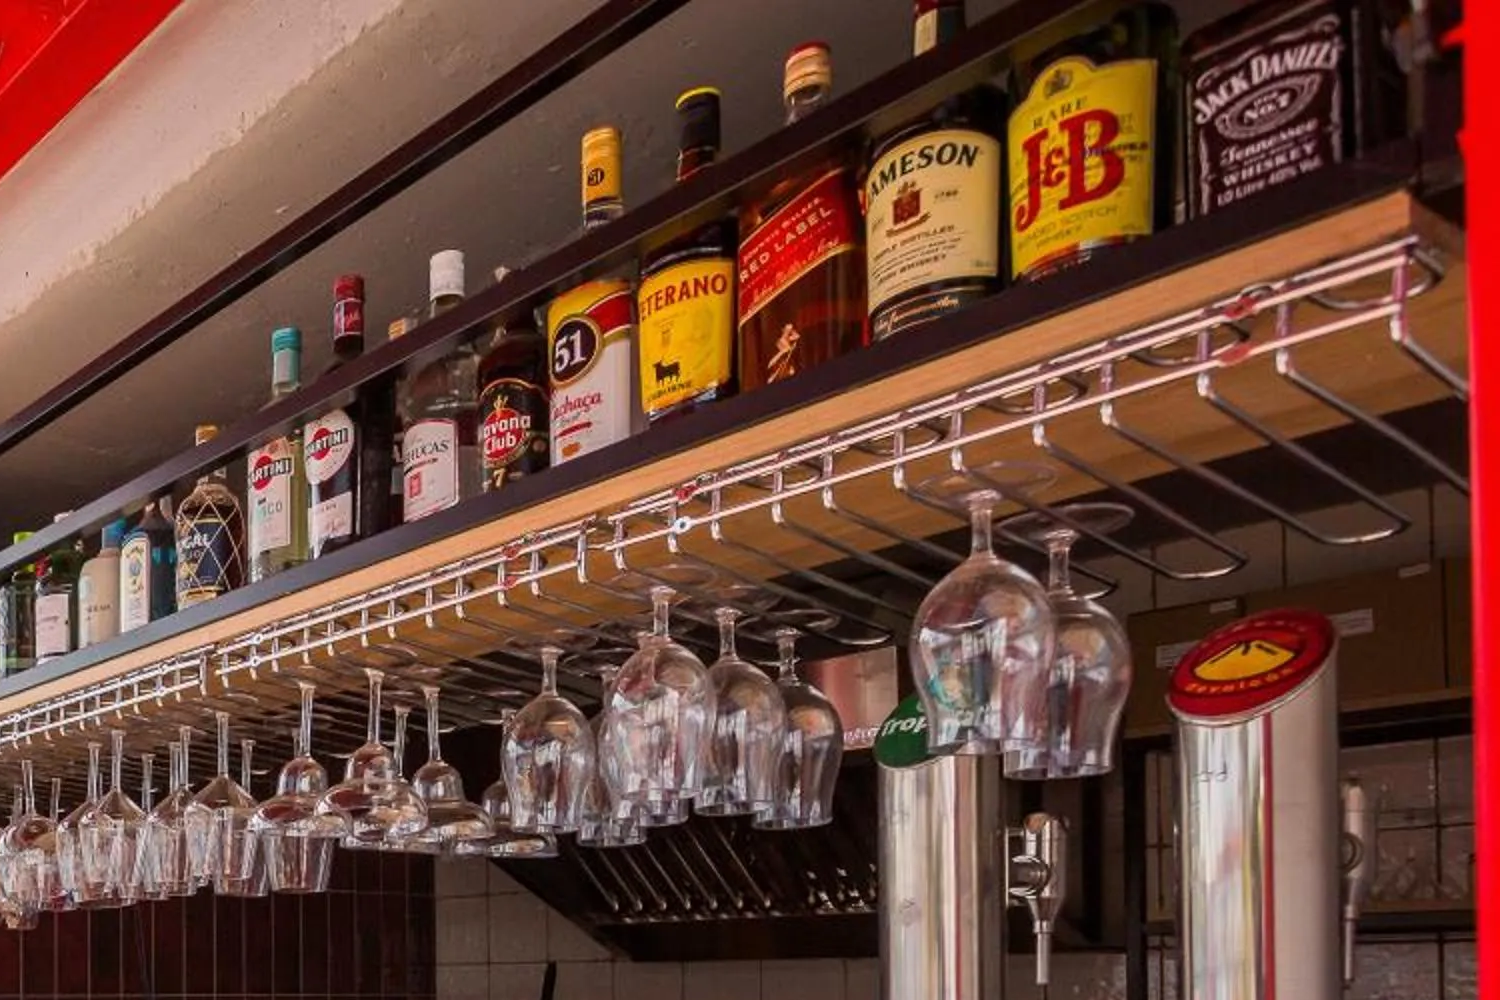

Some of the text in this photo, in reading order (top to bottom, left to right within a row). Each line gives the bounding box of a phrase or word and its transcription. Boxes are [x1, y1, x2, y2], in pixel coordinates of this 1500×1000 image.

[1193, 68, 1250, 125] JACK
[869, 142, 980, 198] AMESON
[1015, 109, 1125, 233] J&B
[1223, 141, 1316, 187] WHISKEY
[739, 250, 772, 284] RED
[773, 207, 834, 252] LABEL
[639, 273, 728, 322] ETERANO
[555, 328, 587, 372] 51
[484, 415, 531, 438] avana
[248, 457, 293, 481] ARTINI
